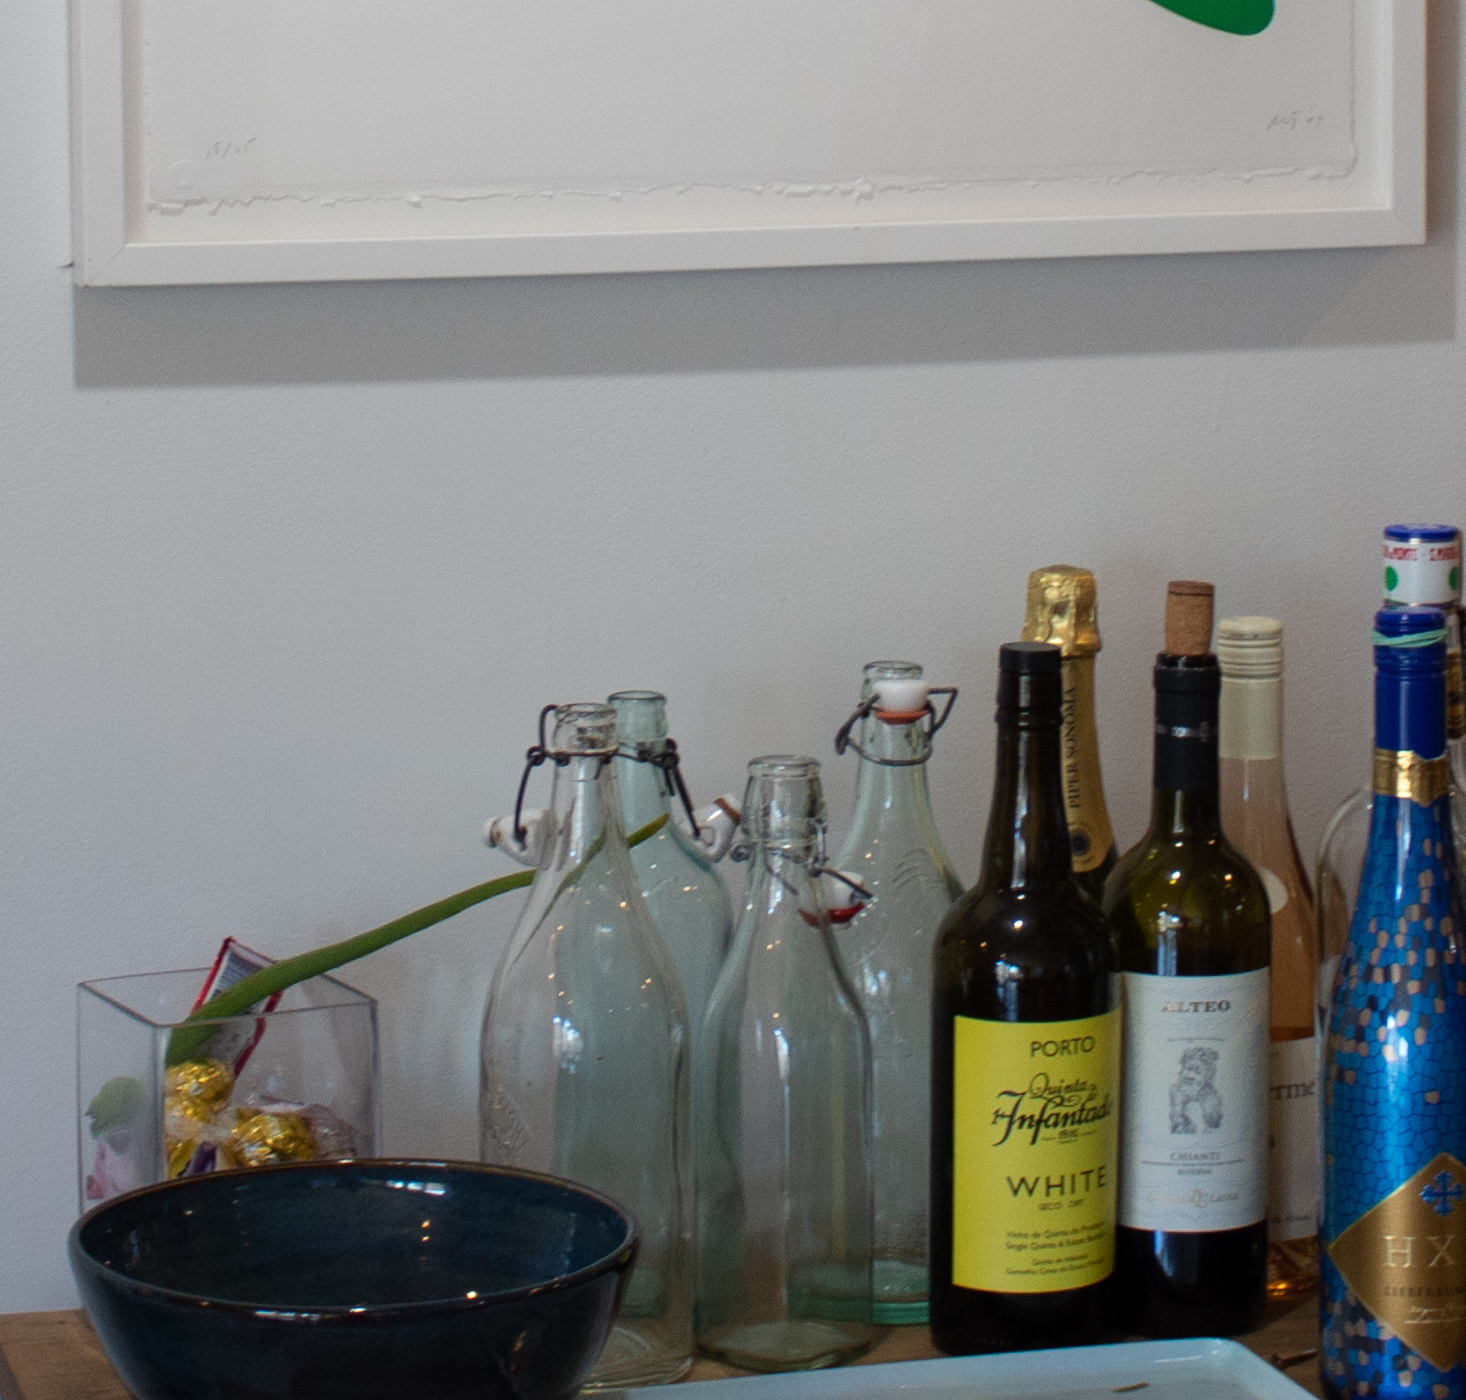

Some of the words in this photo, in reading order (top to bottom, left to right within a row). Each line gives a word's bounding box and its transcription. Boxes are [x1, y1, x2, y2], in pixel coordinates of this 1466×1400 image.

[1162, 1000, 1231, 1013] ALTEO
[1030, 1035, 1096, 1057] PORTO
[1006, 1165, 1106, 1198] WHITE
